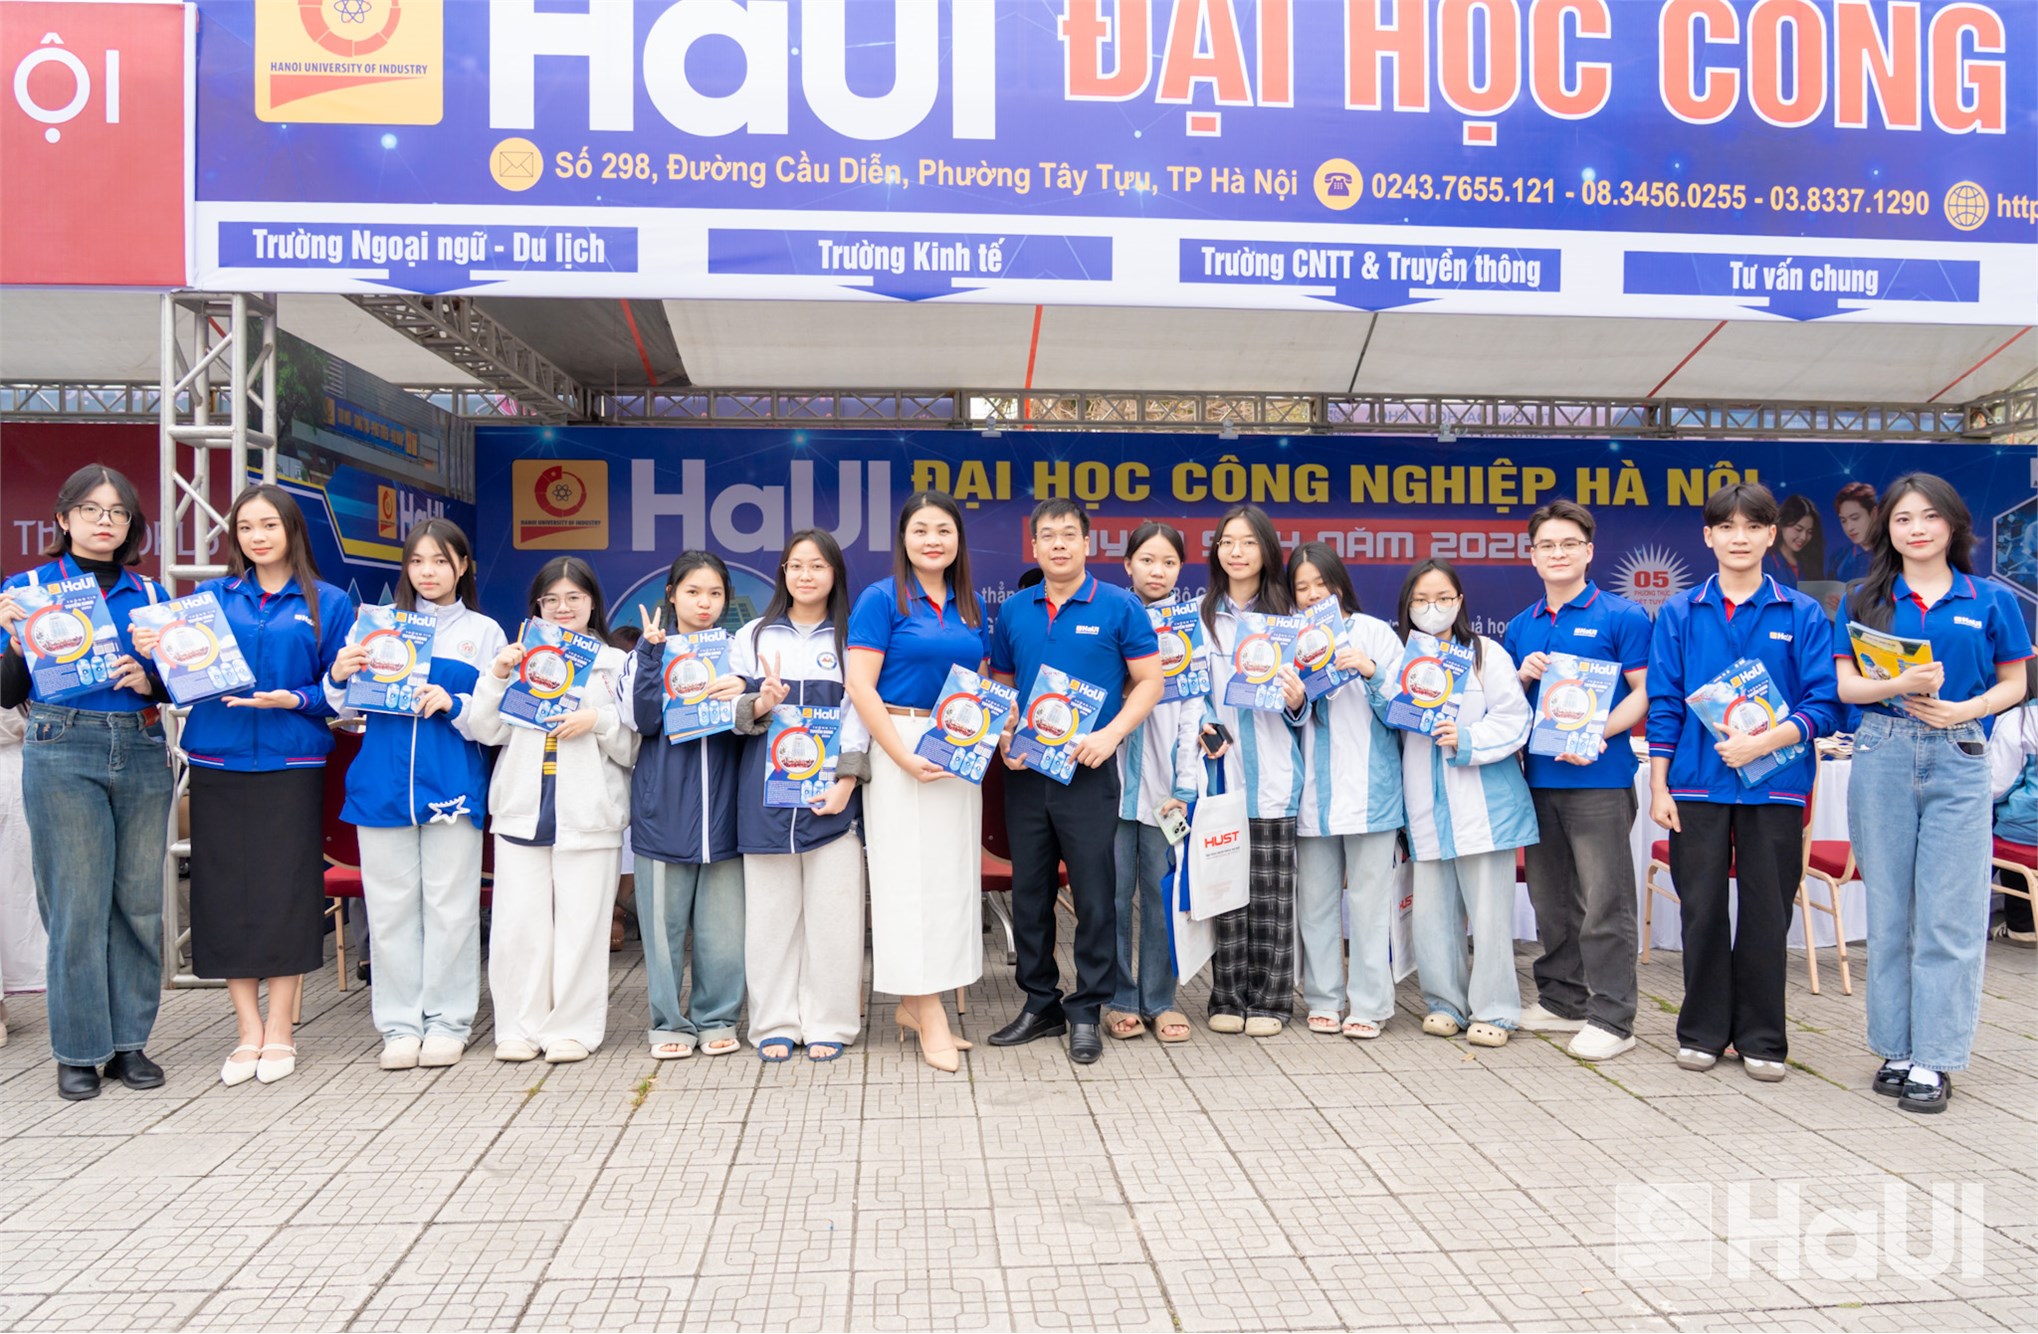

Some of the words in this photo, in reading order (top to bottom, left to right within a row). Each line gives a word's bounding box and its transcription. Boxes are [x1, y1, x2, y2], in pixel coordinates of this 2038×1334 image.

[270, 62, 301, 72] HANOI
[304, 62, 362, 74] UNIVERSITY
[364, 63, 376, 73] OF
[379, 64, 428, 75] INDUSTRY
[1057, 0, 1294, 137] ĐẠI
[1343, 0, 1612, 146] HỌC
[13, 32, 119, 143] ỘI
[555, 146, 593, 179] Số
[602, 152, 659, 184] 298,
[667, 153, 766, 188] Đường
[775, 151, 831, 183] Cầu
[839, 153, 910, 189] Diễn,
[918, 159, 1031, 194] Phường
[1039, 162, 1088, 195] Tây
[1096, 163, 1158, 197] Tựu,
[1167, 166, 1202, 192] TP
[1211, 167, 1245, 194] Hà
[1254, 168, 1299, 201] Nội
[1371, 172, 1554, 204] 0243.7655.121
[1581, 179, 1747, 210] 08.3456.0255
[1770, 185, 1930, 216] 03.8337.1290
[252, 228, 343, 263] Trường
[351, 230, 429, 267] Ngoại
[437, 229, 487, 266] ngữ
[512, 232, 547, 263] Du
[555, 232, 605, 269] lịch
[818, 238, 906, 273] Trường
[913, 240, 969, 273] Kinh
[977, 237, 1006, 273] tế
[1201, 246, 1284, 281] Trường
[1292, 248, 1354, 279] CNTT
[1361, 251, 1380, 280] &
[1388, 248, 1468, 284] Truyền
[1474, 253, 1541, 288] thông
[1729, 260, 1758, 291] Tư
[1763, 256, 1803, 292] vấn
[1809, 262, 1879, 296] chung
[631, 459, 891, 552] HaUI
[911, 459, 1011, 509] ĐẠI
[1034, 461, 1151, 510] HỌC
[1172, 455, 1329, 503] CÔNG
[1351, 458, 1557, 513] NGHIỆP
[1576, 459, 1649, 506] HÀ
[61, 577, 95, 592] HaUI
[1633, 570, 1670, 588] 05
[1172, 602, 1198, 616] HaUI
[408, 613, 436, 628] HaUI
[572, 635, 600, 653] HaUI
[699, 630, 726, 643] HaUI
[1449, 645, 1475, 661] HaUI
[1590, 664, 1619, 676] HaUI
[1739, 662, 1766, 684] HaUI
[990, 683, 1017, 700] HaUI
[1079, 683, 1107, 702] HaUI
[813, 709, 840, 721] HaUI
[1204, 830, 1240, 848] HUST
